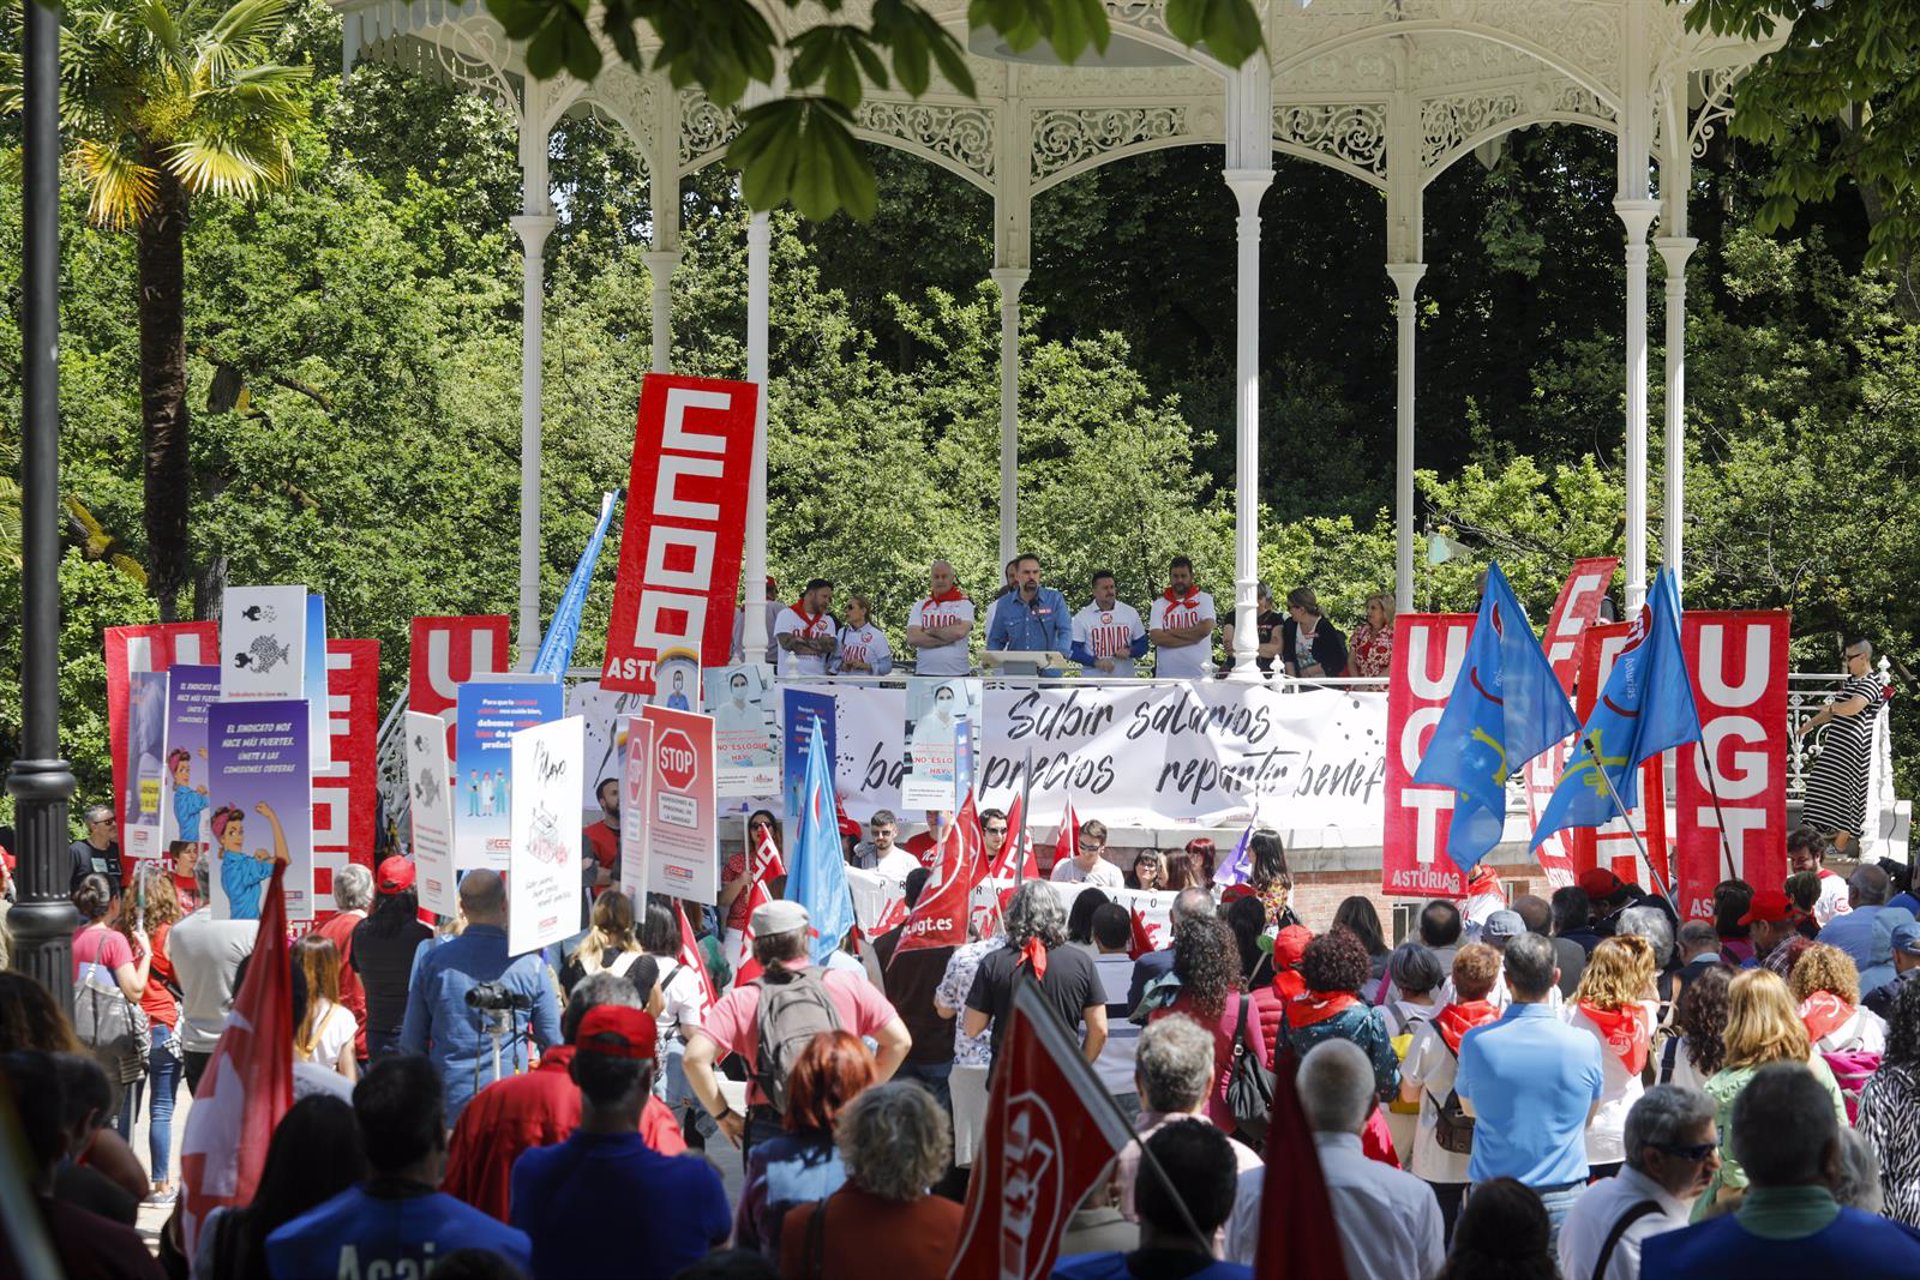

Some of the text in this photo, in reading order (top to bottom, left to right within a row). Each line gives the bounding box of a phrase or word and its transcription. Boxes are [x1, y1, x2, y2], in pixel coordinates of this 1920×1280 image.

[634, 388, 732, 650] CCOO
[226, 724, 235, 733] EL
[275, 722, 292, 732] NOS
[477, 719, 514, 728] debemos
[1007, 690, 1271, 744] Subir salarios
[661, 746, 693, 774] STOP
[979, 751, 1115, 801] precios
[1694, 624, 1771, 885] UGT
